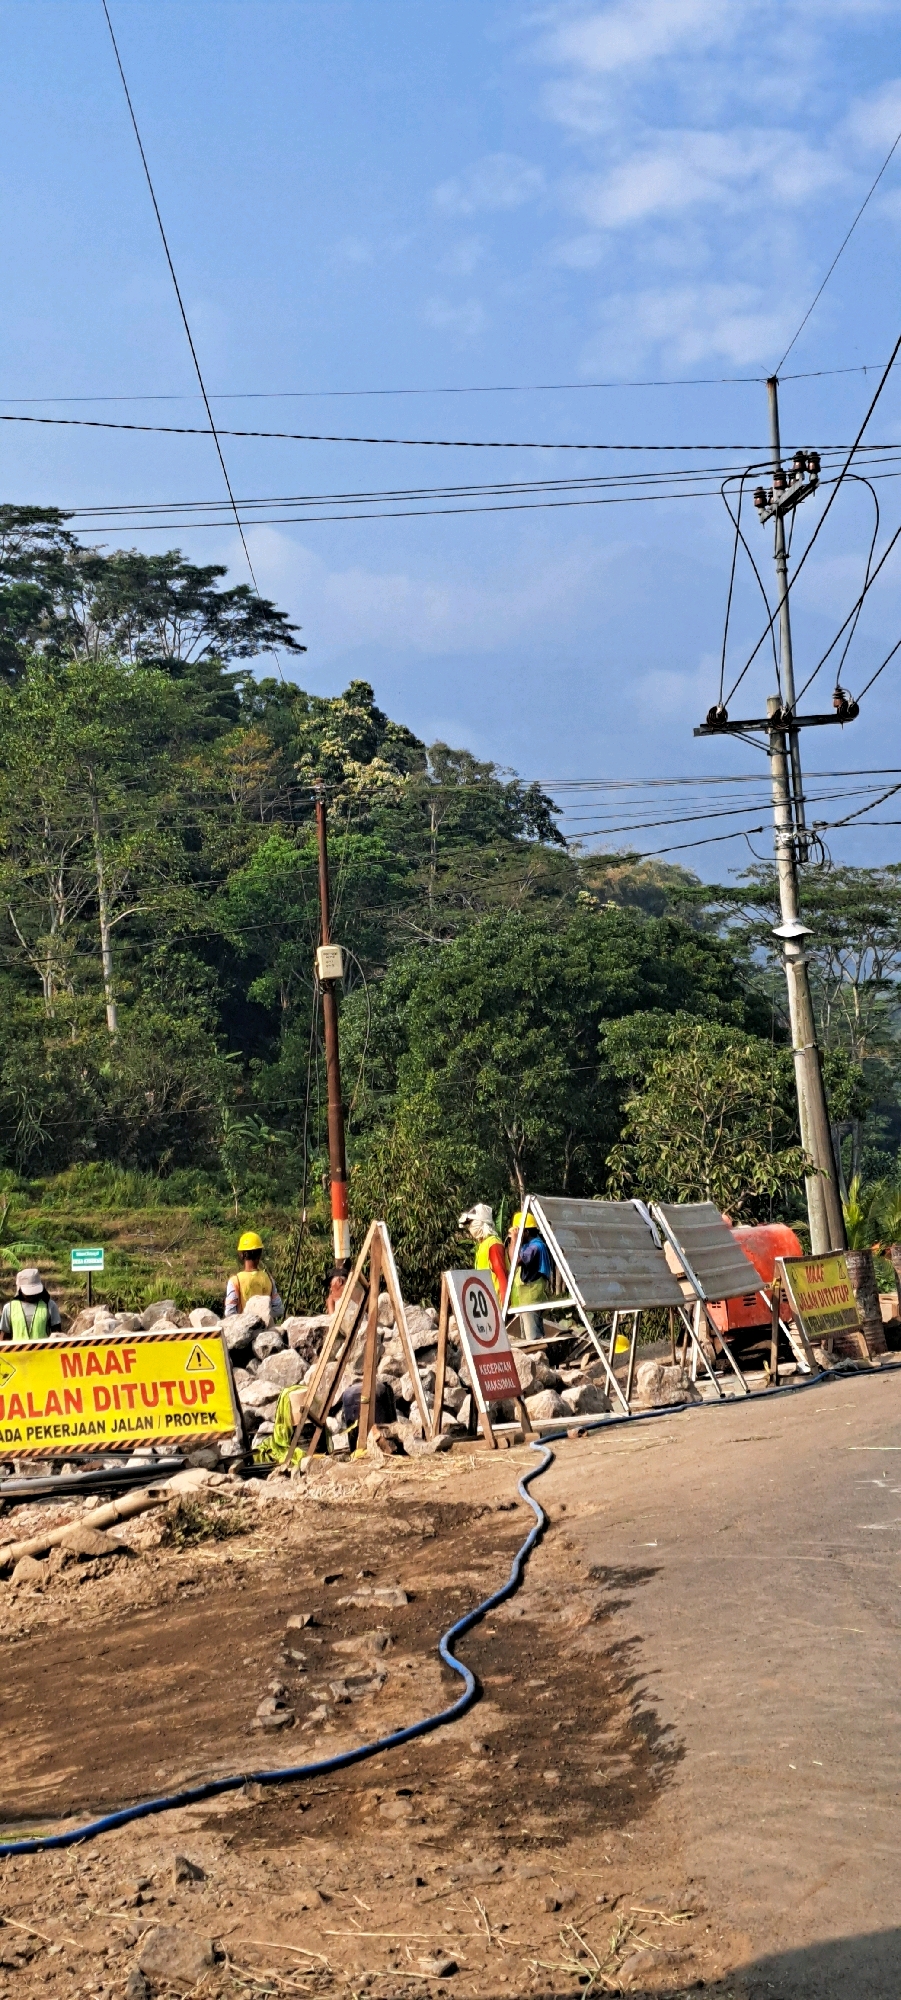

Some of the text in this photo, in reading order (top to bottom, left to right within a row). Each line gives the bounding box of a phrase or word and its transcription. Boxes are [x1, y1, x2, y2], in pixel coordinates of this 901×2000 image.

[805, 1264, 824, 1283] MAAF
[469, 1290, 488, 1318] 20
[798, 1284, 849, 1311] JALAN DITUTUP
[60, 1349, 137, 1378] MAAF
[479, 1361, 512, 1375] KECEPATAN
[93, 1379, 215, 1412] DITUTUP
[484, 1378, 516, 1392] MAKSIMAL
[26, 1420, 106, 1440] PEKERJAAN
[111, 1416, 154, 1433] JALAN
[165, 1412, 218, 1427] PROYEK
